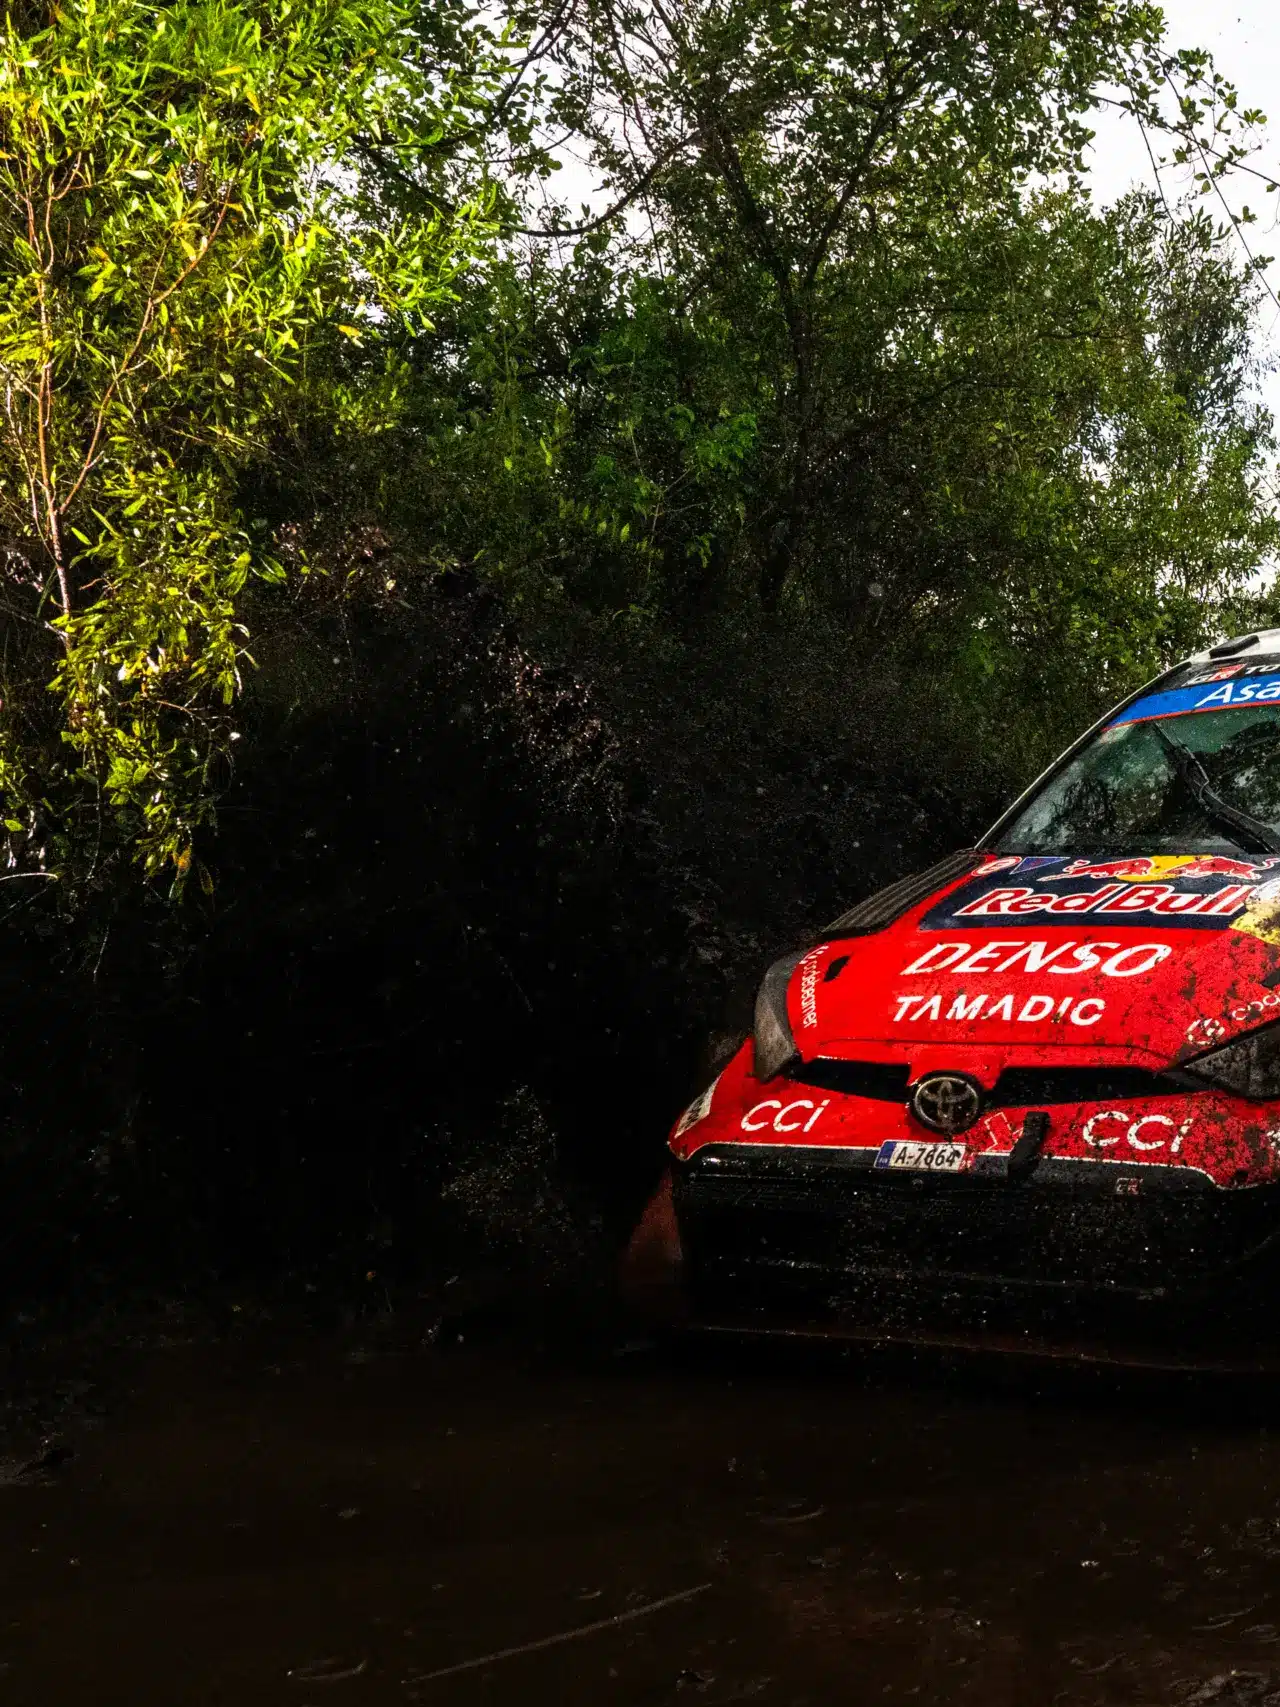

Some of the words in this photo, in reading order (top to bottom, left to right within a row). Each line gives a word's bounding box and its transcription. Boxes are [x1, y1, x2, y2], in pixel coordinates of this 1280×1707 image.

[953, 884, 1119, 916] Red
[1094, 884, 1256, 916] Bull
[900, 941, 1172, 977] DENSO
[893, 994, 1106, 1026] TAMADIC
[895, 1147, 957, 1166] A-7664
